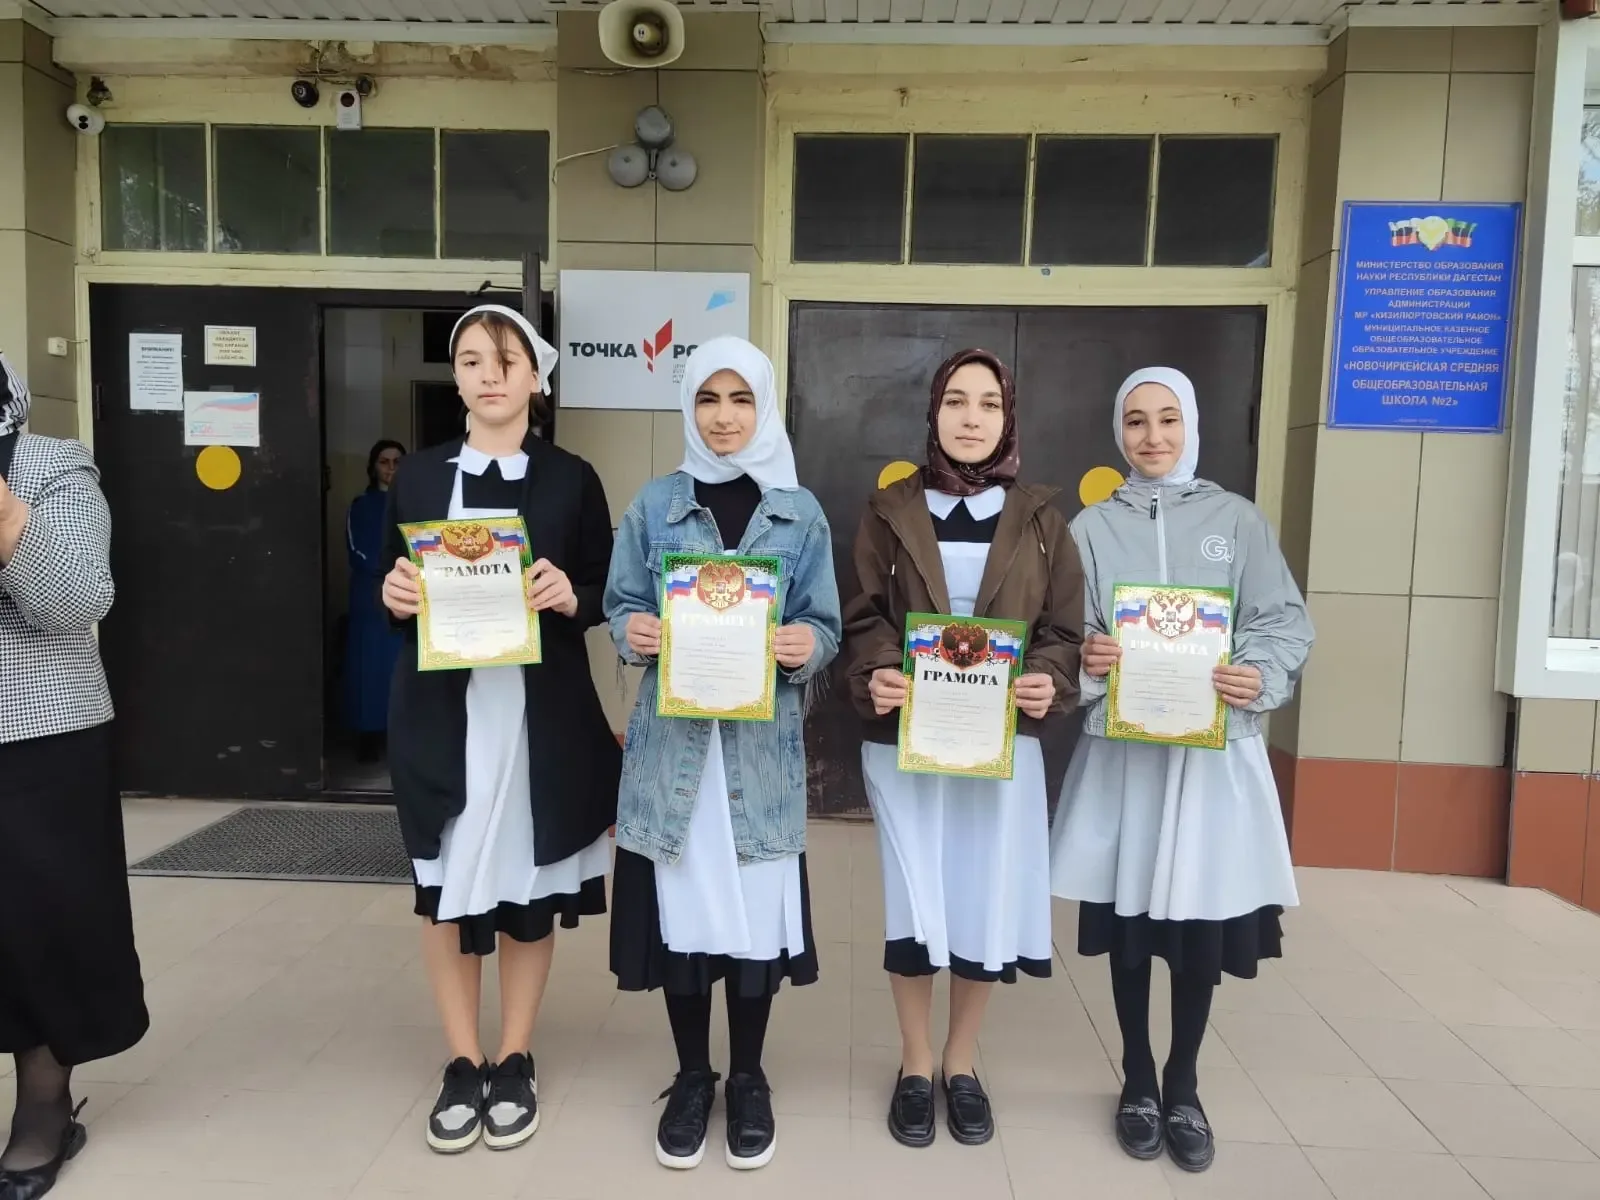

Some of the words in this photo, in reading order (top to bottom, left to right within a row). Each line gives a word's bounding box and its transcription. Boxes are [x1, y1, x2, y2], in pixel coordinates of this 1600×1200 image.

[1356, 261, 1432, 269] МИНИСТЕРСТВО
[1434, 262, 1504, 270] ОБРАЗОВАНИЯ
[1356, 273, 1387, 281] НАУКИ
[1389, 273, 1451, 281] РЕСПУБЛИКИ
[1452, 274, 1501, 282] ДАГЕСТАН
[1364, 288, 1425, 296] УПРАВЛЕНИЕ
[1427, 289, 1496, 297] ОБРАЗОВАНИЯ
[1388, 300, 1470, 309] АДМИНИСТРАЦИИ
[1364, 325, 1441, 333] МУНИЦИПАЛЬНОЕ
[1370, 336, 1483, 344] ОБЩЕОБРАЗОВАТЕЛЬНОЕ
[569, 342, 638, 358] ТОЧКА
[1352, 346, 1438, 354] ОБРАЗОВАТЕЛЬНОЕ
[1440, 347, 1498, 355] УЧРЕЖДЕНИЕ
[1450, 363, 1499, 373] СРЕДНЯЯ
[1352, 379, 1489, 392] ОБЩЕОБРАЗОВАТЕЛЬНАЯ
[1382, 395, 1428, 405] ШКОЛА
[923, 670, 999, 686] ГРАМОТА
